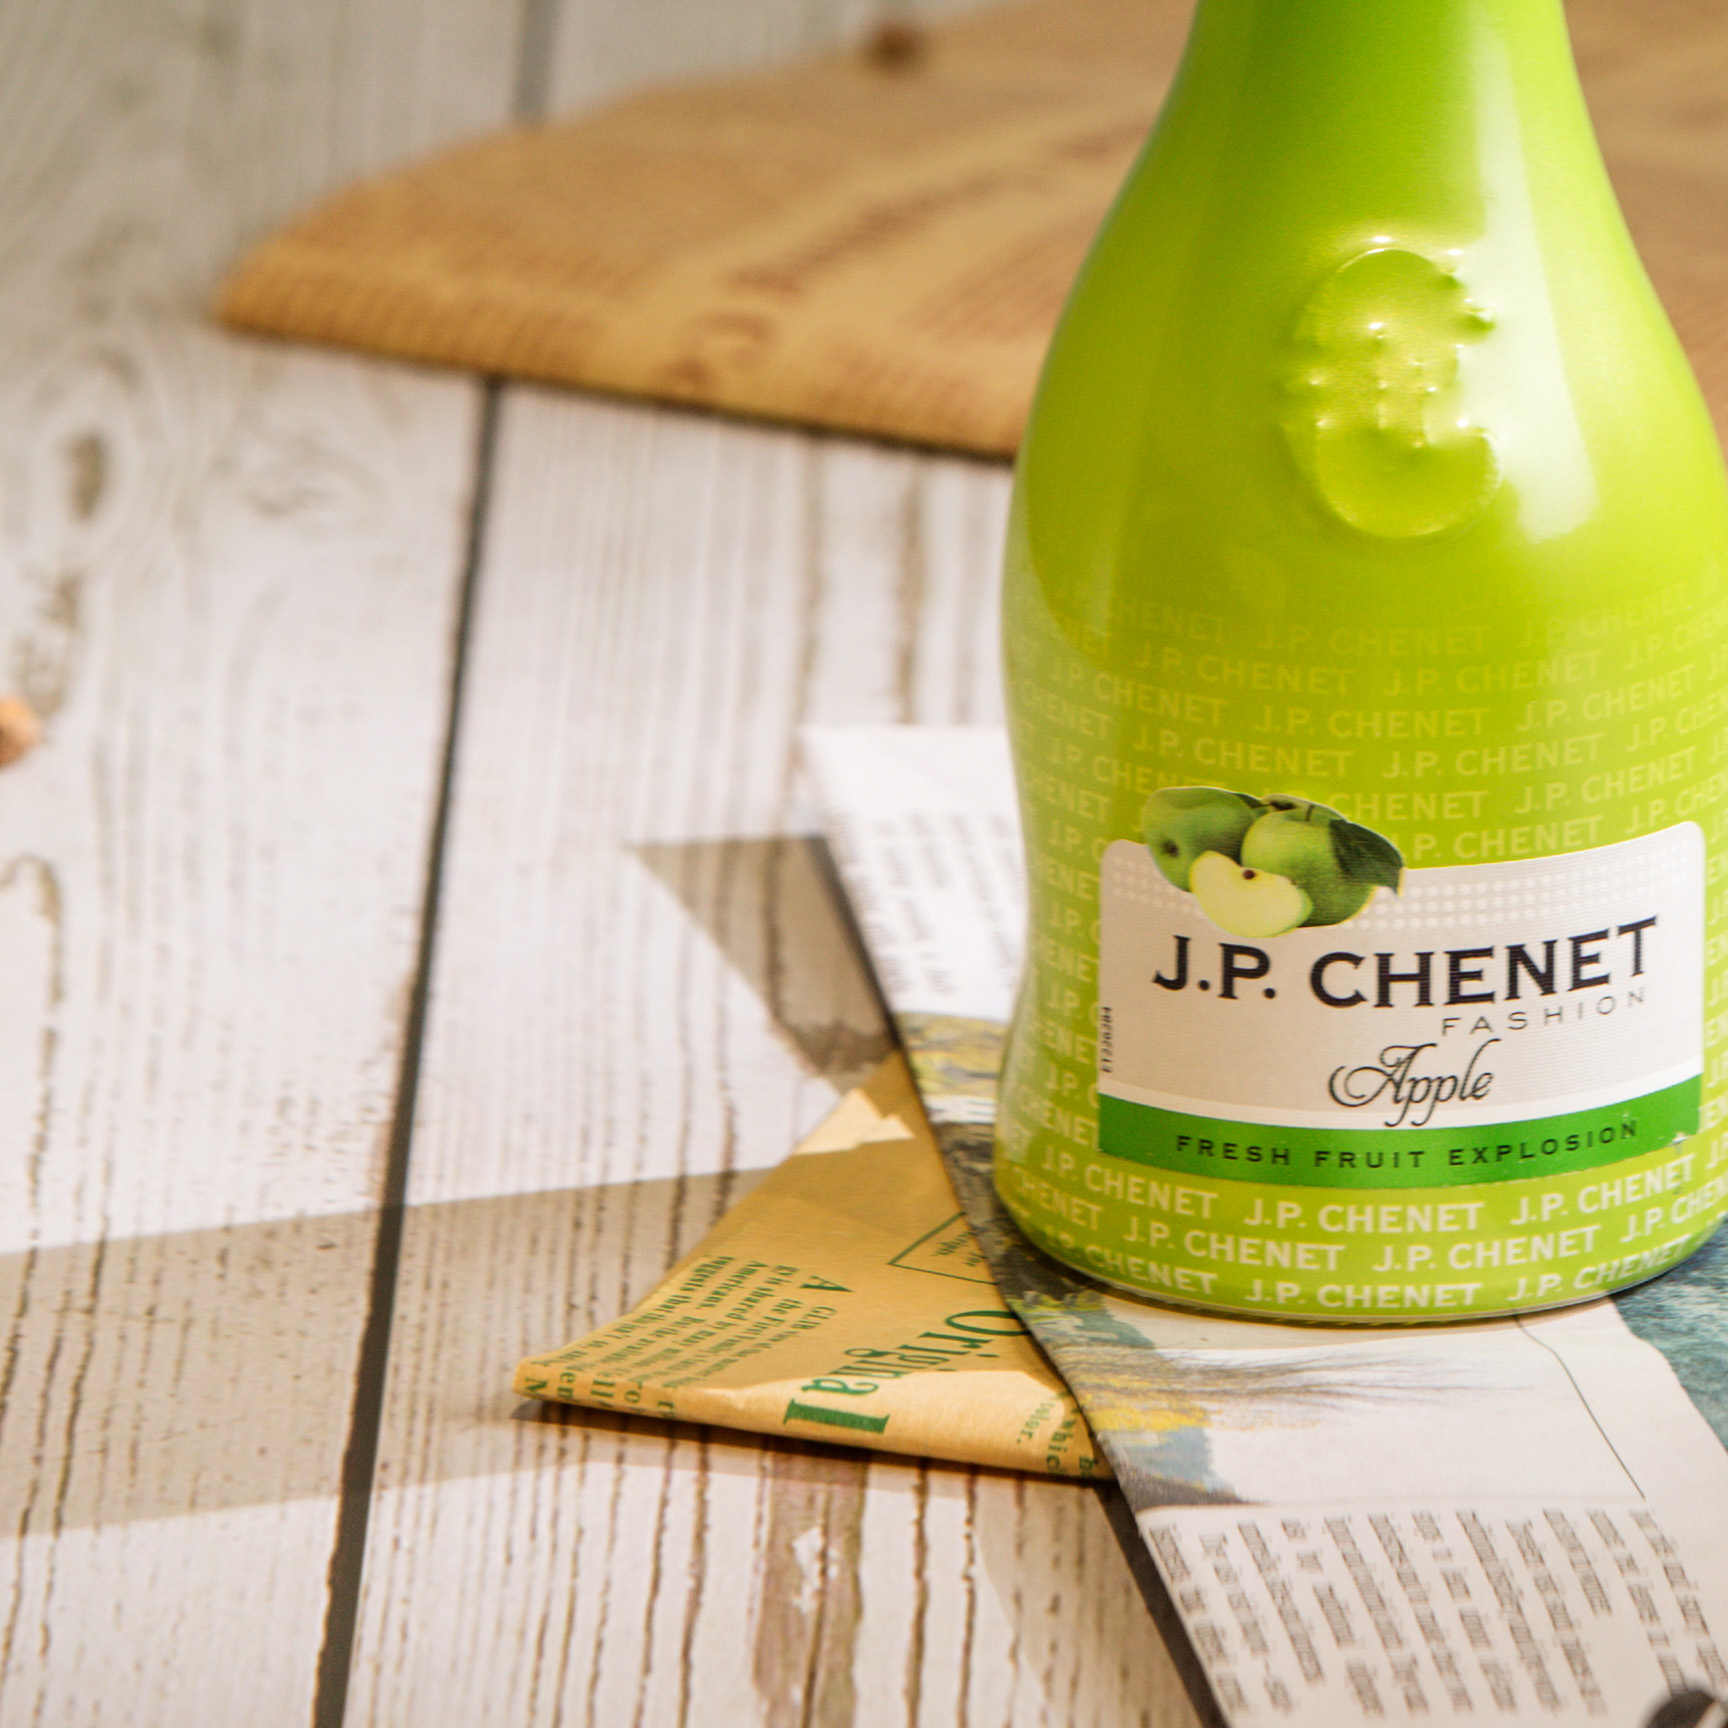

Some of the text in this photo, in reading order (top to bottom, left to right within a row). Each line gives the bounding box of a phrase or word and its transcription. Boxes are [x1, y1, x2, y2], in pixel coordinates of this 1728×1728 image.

[1093, 671, 1230, 726] CHENET
[1255, 704, 1316, 733] J.P.
[1327, 708, 1490, 739] CHENET
[1515, 700, 1571, 733] J.P.
[1581, 663, 1697, 721] CHENET
[1200, 656, 1354, 696] CHENET
[1454, 649, 1603, 693] CHENET
[1193, 737, 1354, 778] CHENET
[1382, 750, 1443, 779] J.P.
[1454, 731, 1605, 777] CHENET
[1327, 790, 1489, 823] CHENET
[1513, 781, 1569, 814] J.P.
[1580, 745, 1698, 803] CHENET
[1452, 815, 1606, 859] CHENET
[1151, 915, 1659, 1011] J.P. CHENET
[1441, 985, 1647, 1038] FASHION
[1328, 1037, 1502, 1129] Apple
[1175, 1117, 1640, 1170] FRESH FRUIT EXPLOSION
[1084, 1162, 1220, 1222] CHENET
[1243, 1197, 1309, 1229] J.P.
[1317, 1201, 1488, 1238] CHENET
[1510, 1192, 1572, 1228] J.P.
[1576, 1152, 1698, 1215] CHENET
[1124, 1217, 1175, 1249] J.P.
[1183, 1229, 1349, 1275] CHENET
[1369, 1242, 1440, 1275] J.P.
[1449, 1224, 1604, 1273] CHENET
[1619, 1204, 1667, 1246] J.P.
[1244, 1278, 1309, 1307] J.P.
[1315, 1282, 1484, 1311] CHENET
[1506, 1270, 1564, 1304] J.P.
[1572, 1231, 1695, 1292] CHENET
[653, 1293, 693, 1314] that
[724, 1286, 776, 1320] shared
[771, 1298, 804, 1314] the
[782, 1309, 1032, 1434] Original
